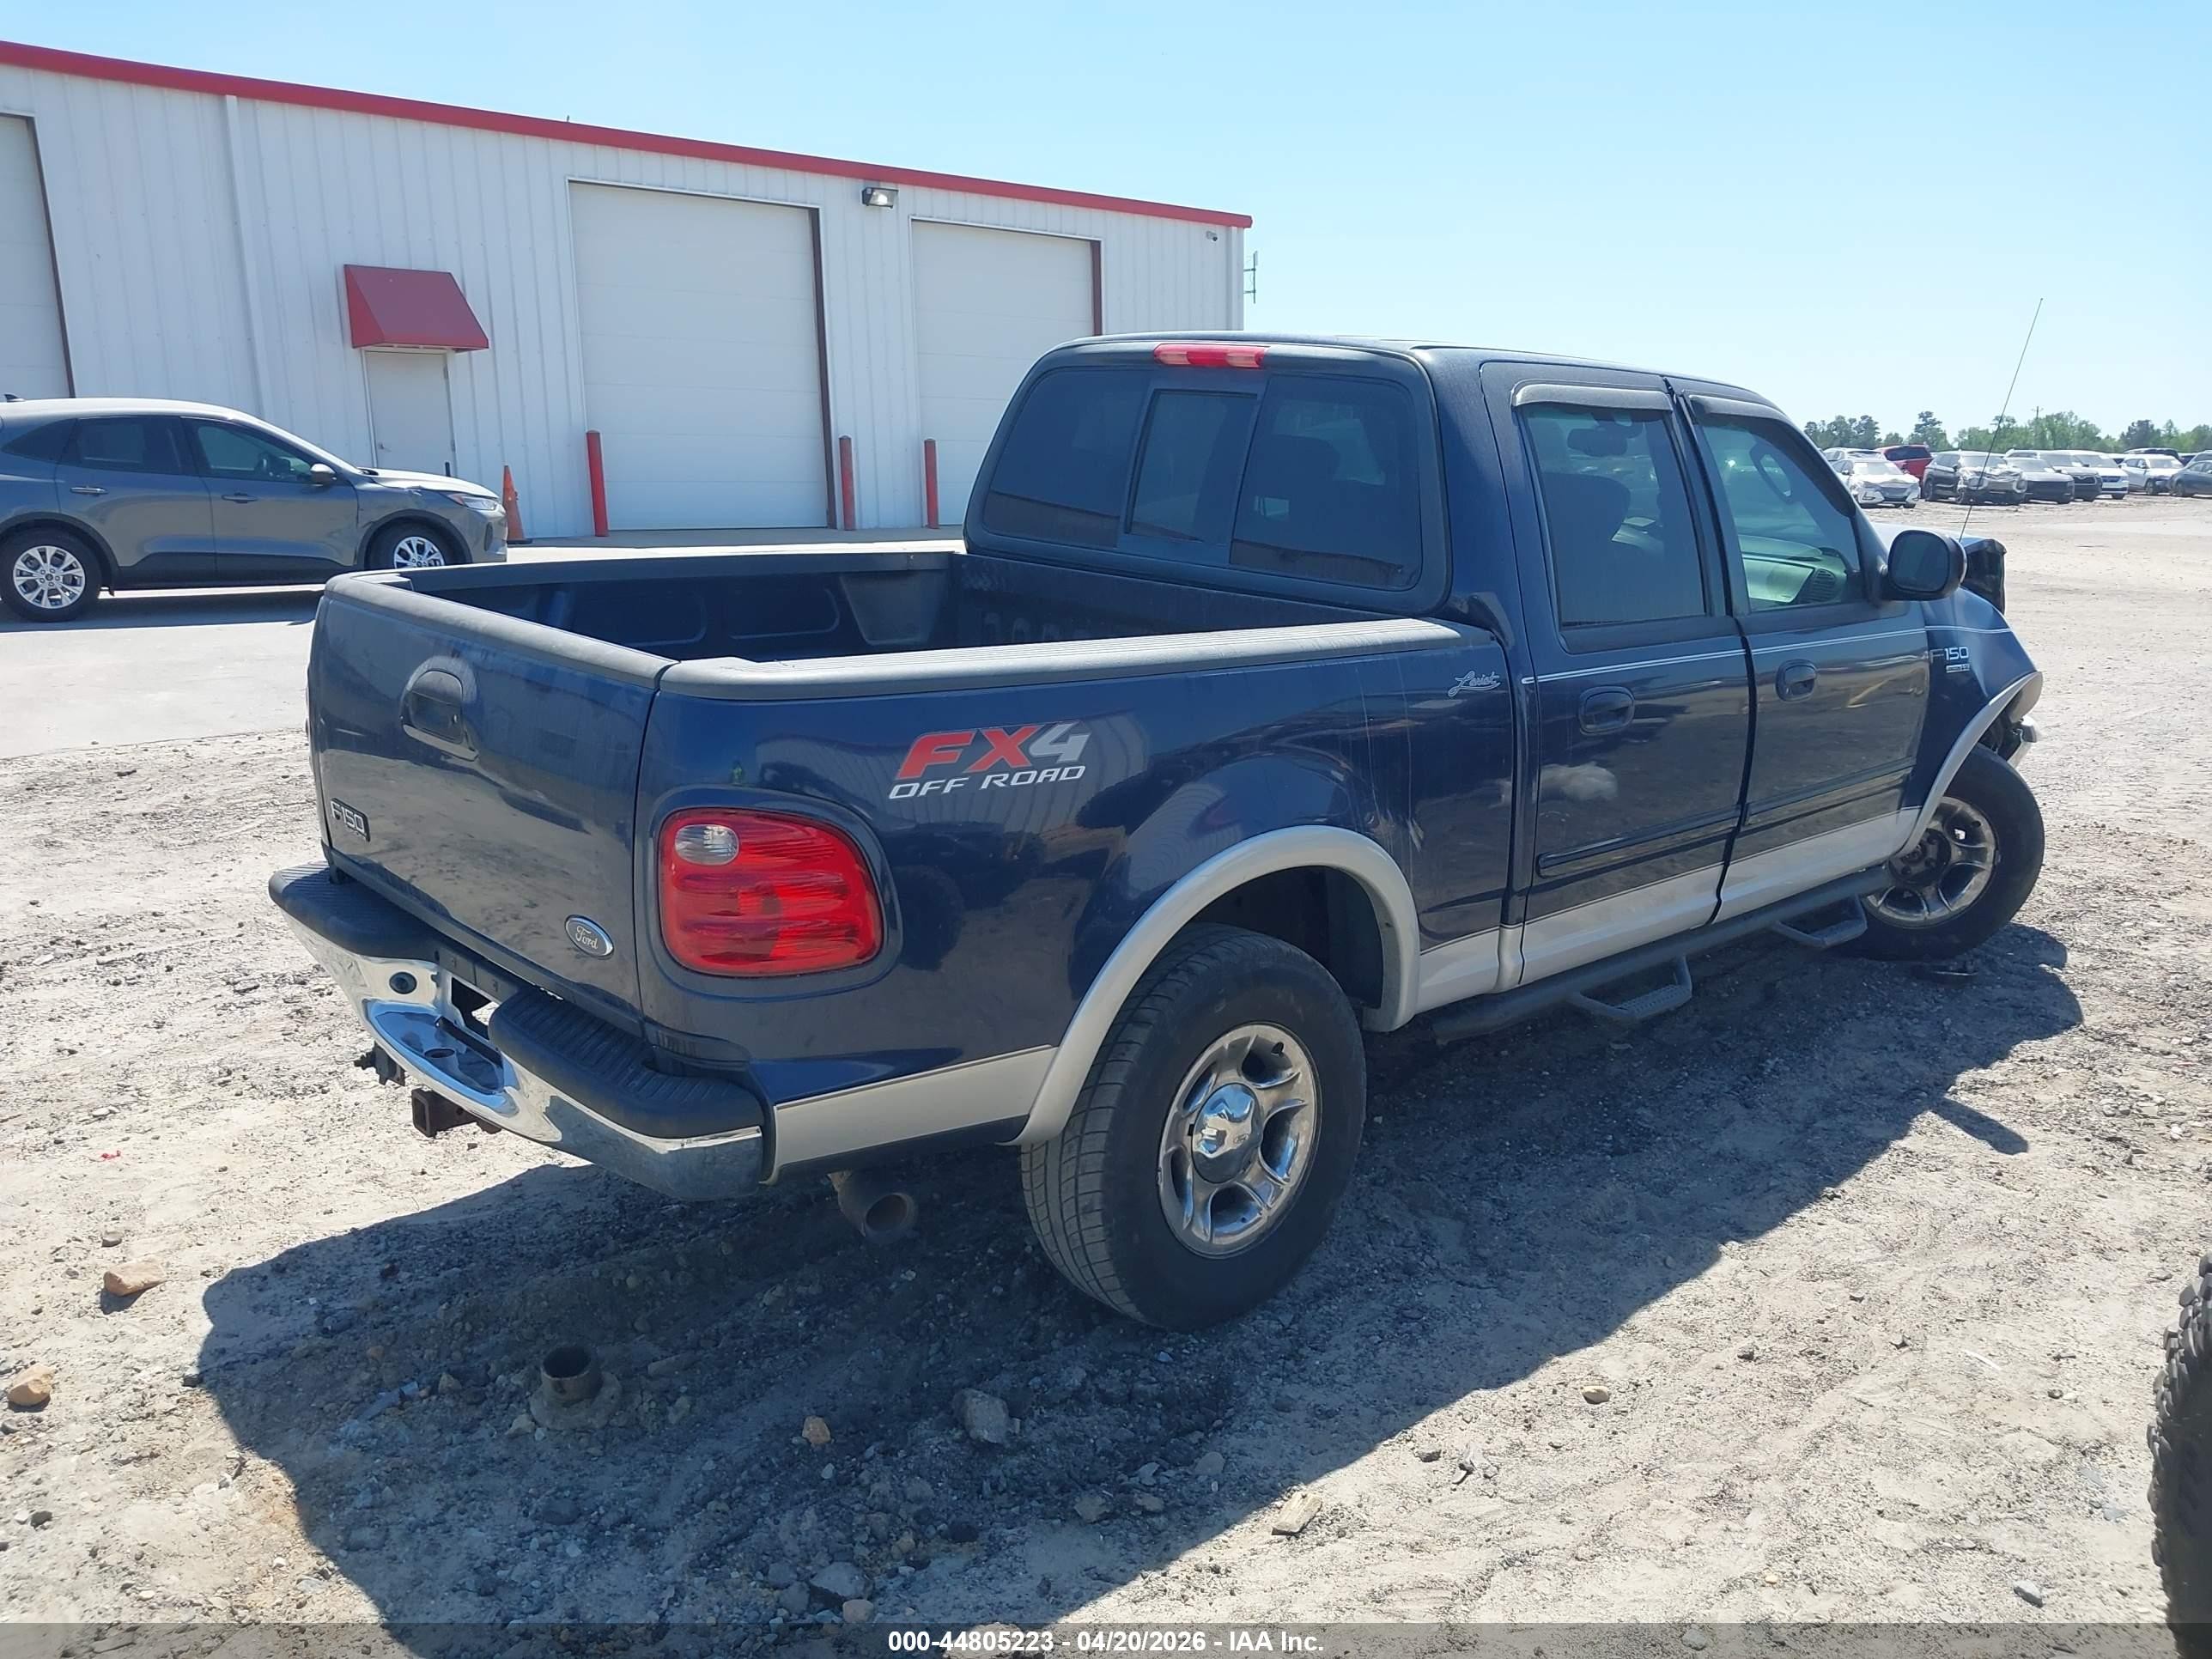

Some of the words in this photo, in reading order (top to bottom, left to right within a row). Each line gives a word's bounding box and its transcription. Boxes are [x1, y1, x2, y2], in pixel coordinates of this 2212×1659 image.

[896, 720, 1091, 780] FX4
[888, 776, 970, 799] OFF
[979, 765, 1086, 790] ROAD
[575, 925, 599, 950] Ford
